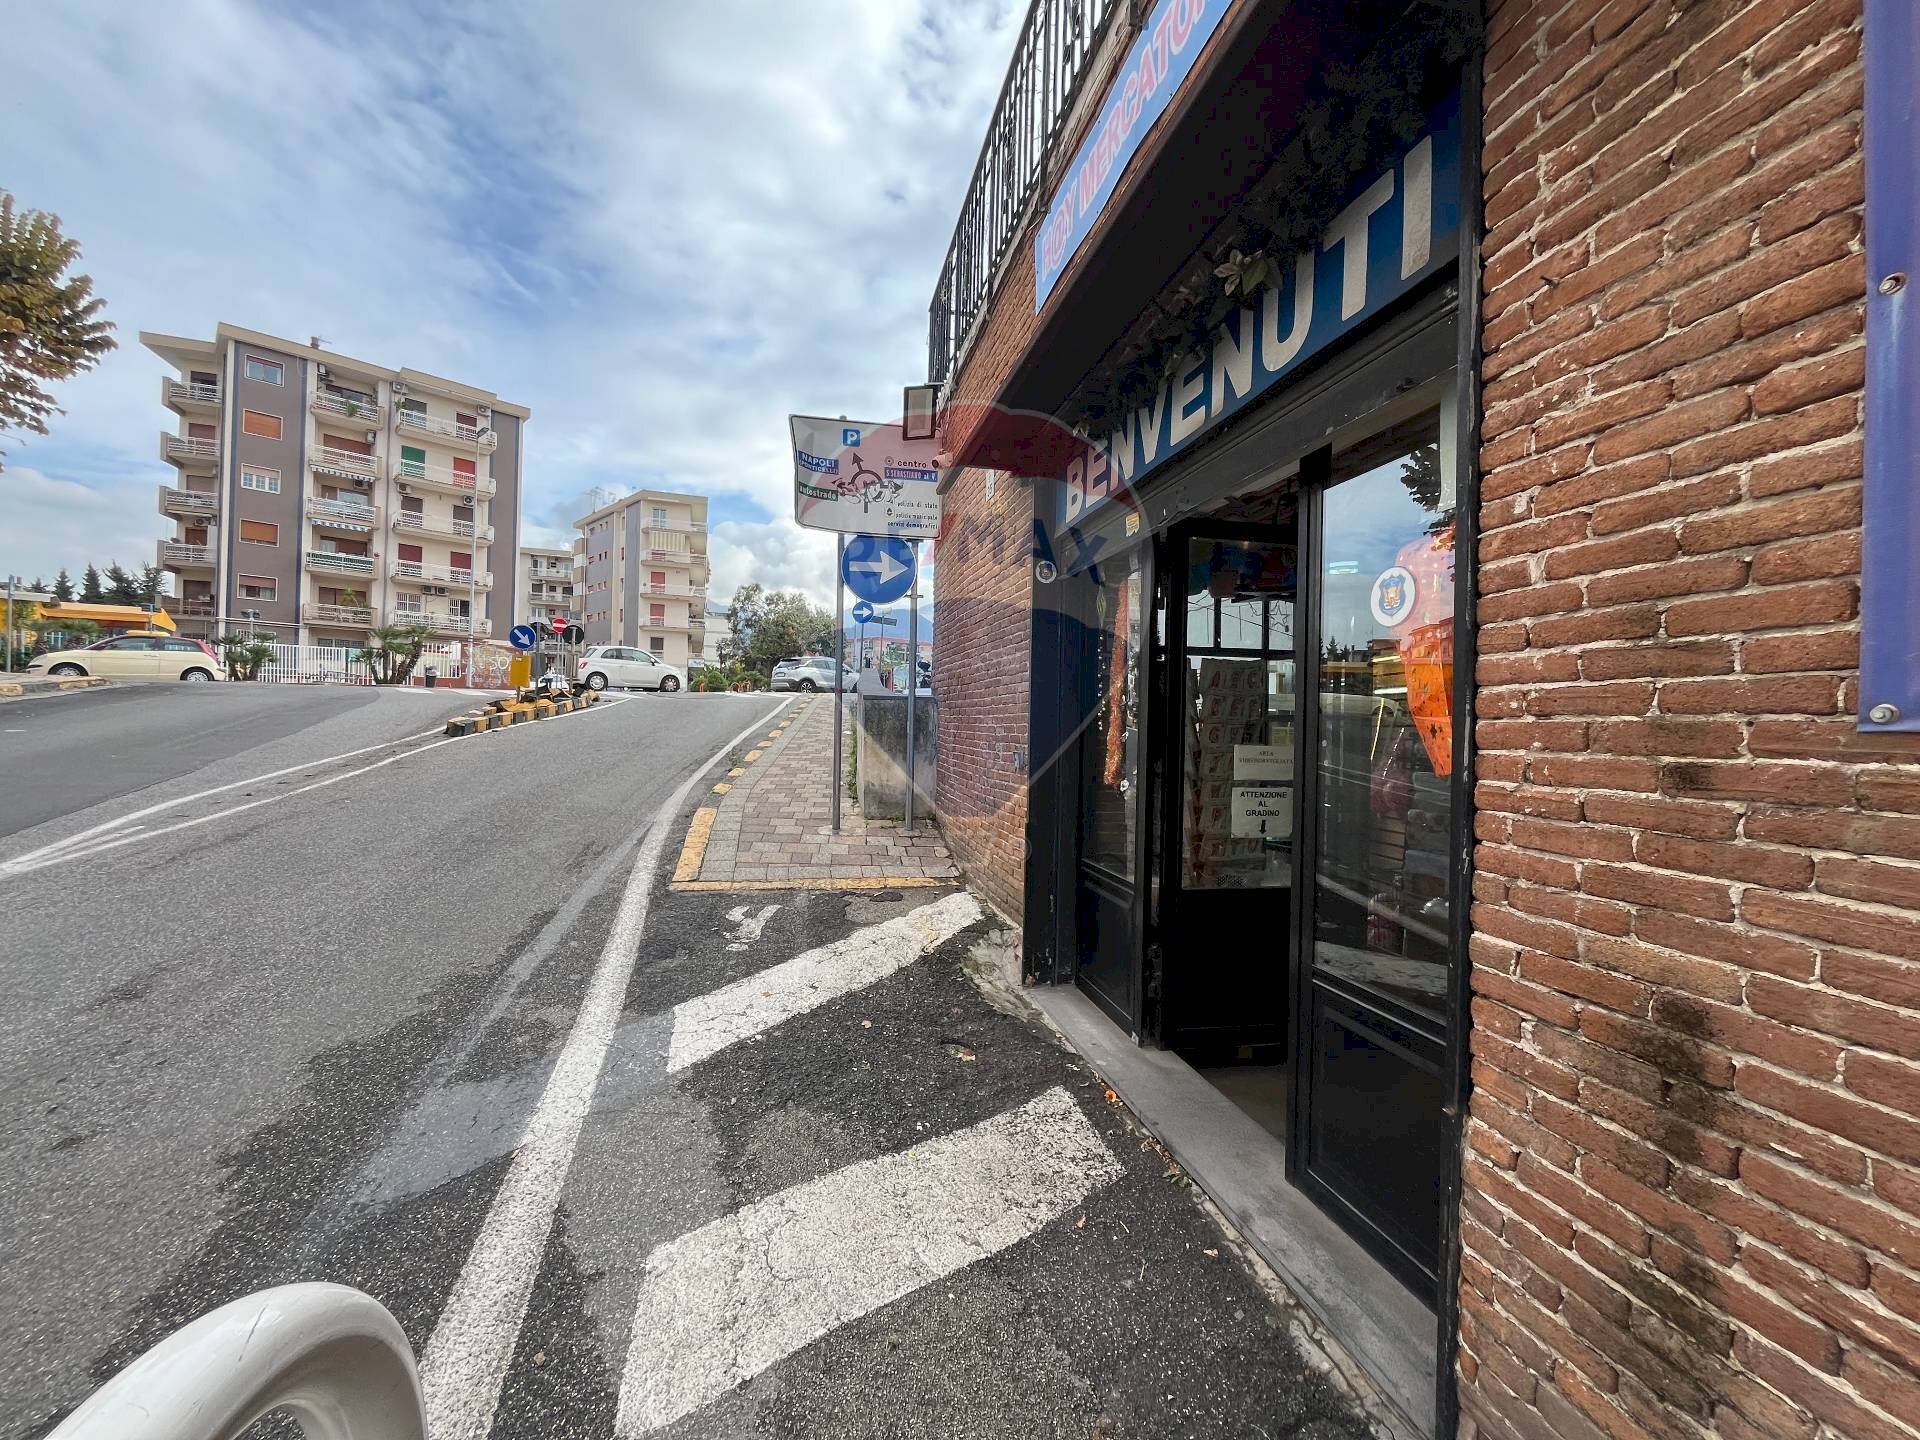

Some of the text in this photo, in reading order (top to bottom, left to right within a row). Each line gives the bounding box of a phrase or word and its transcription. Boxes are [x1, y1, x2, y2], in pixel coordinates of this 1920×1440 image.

[1064, 134, 1433, 524] BENVENUTI
[847, 432, 858, 445] P
[801, 452, 835, 467] NAPOLI
[897, 460, 927, 469] centro
[905, 522, 938, 530] demografici
